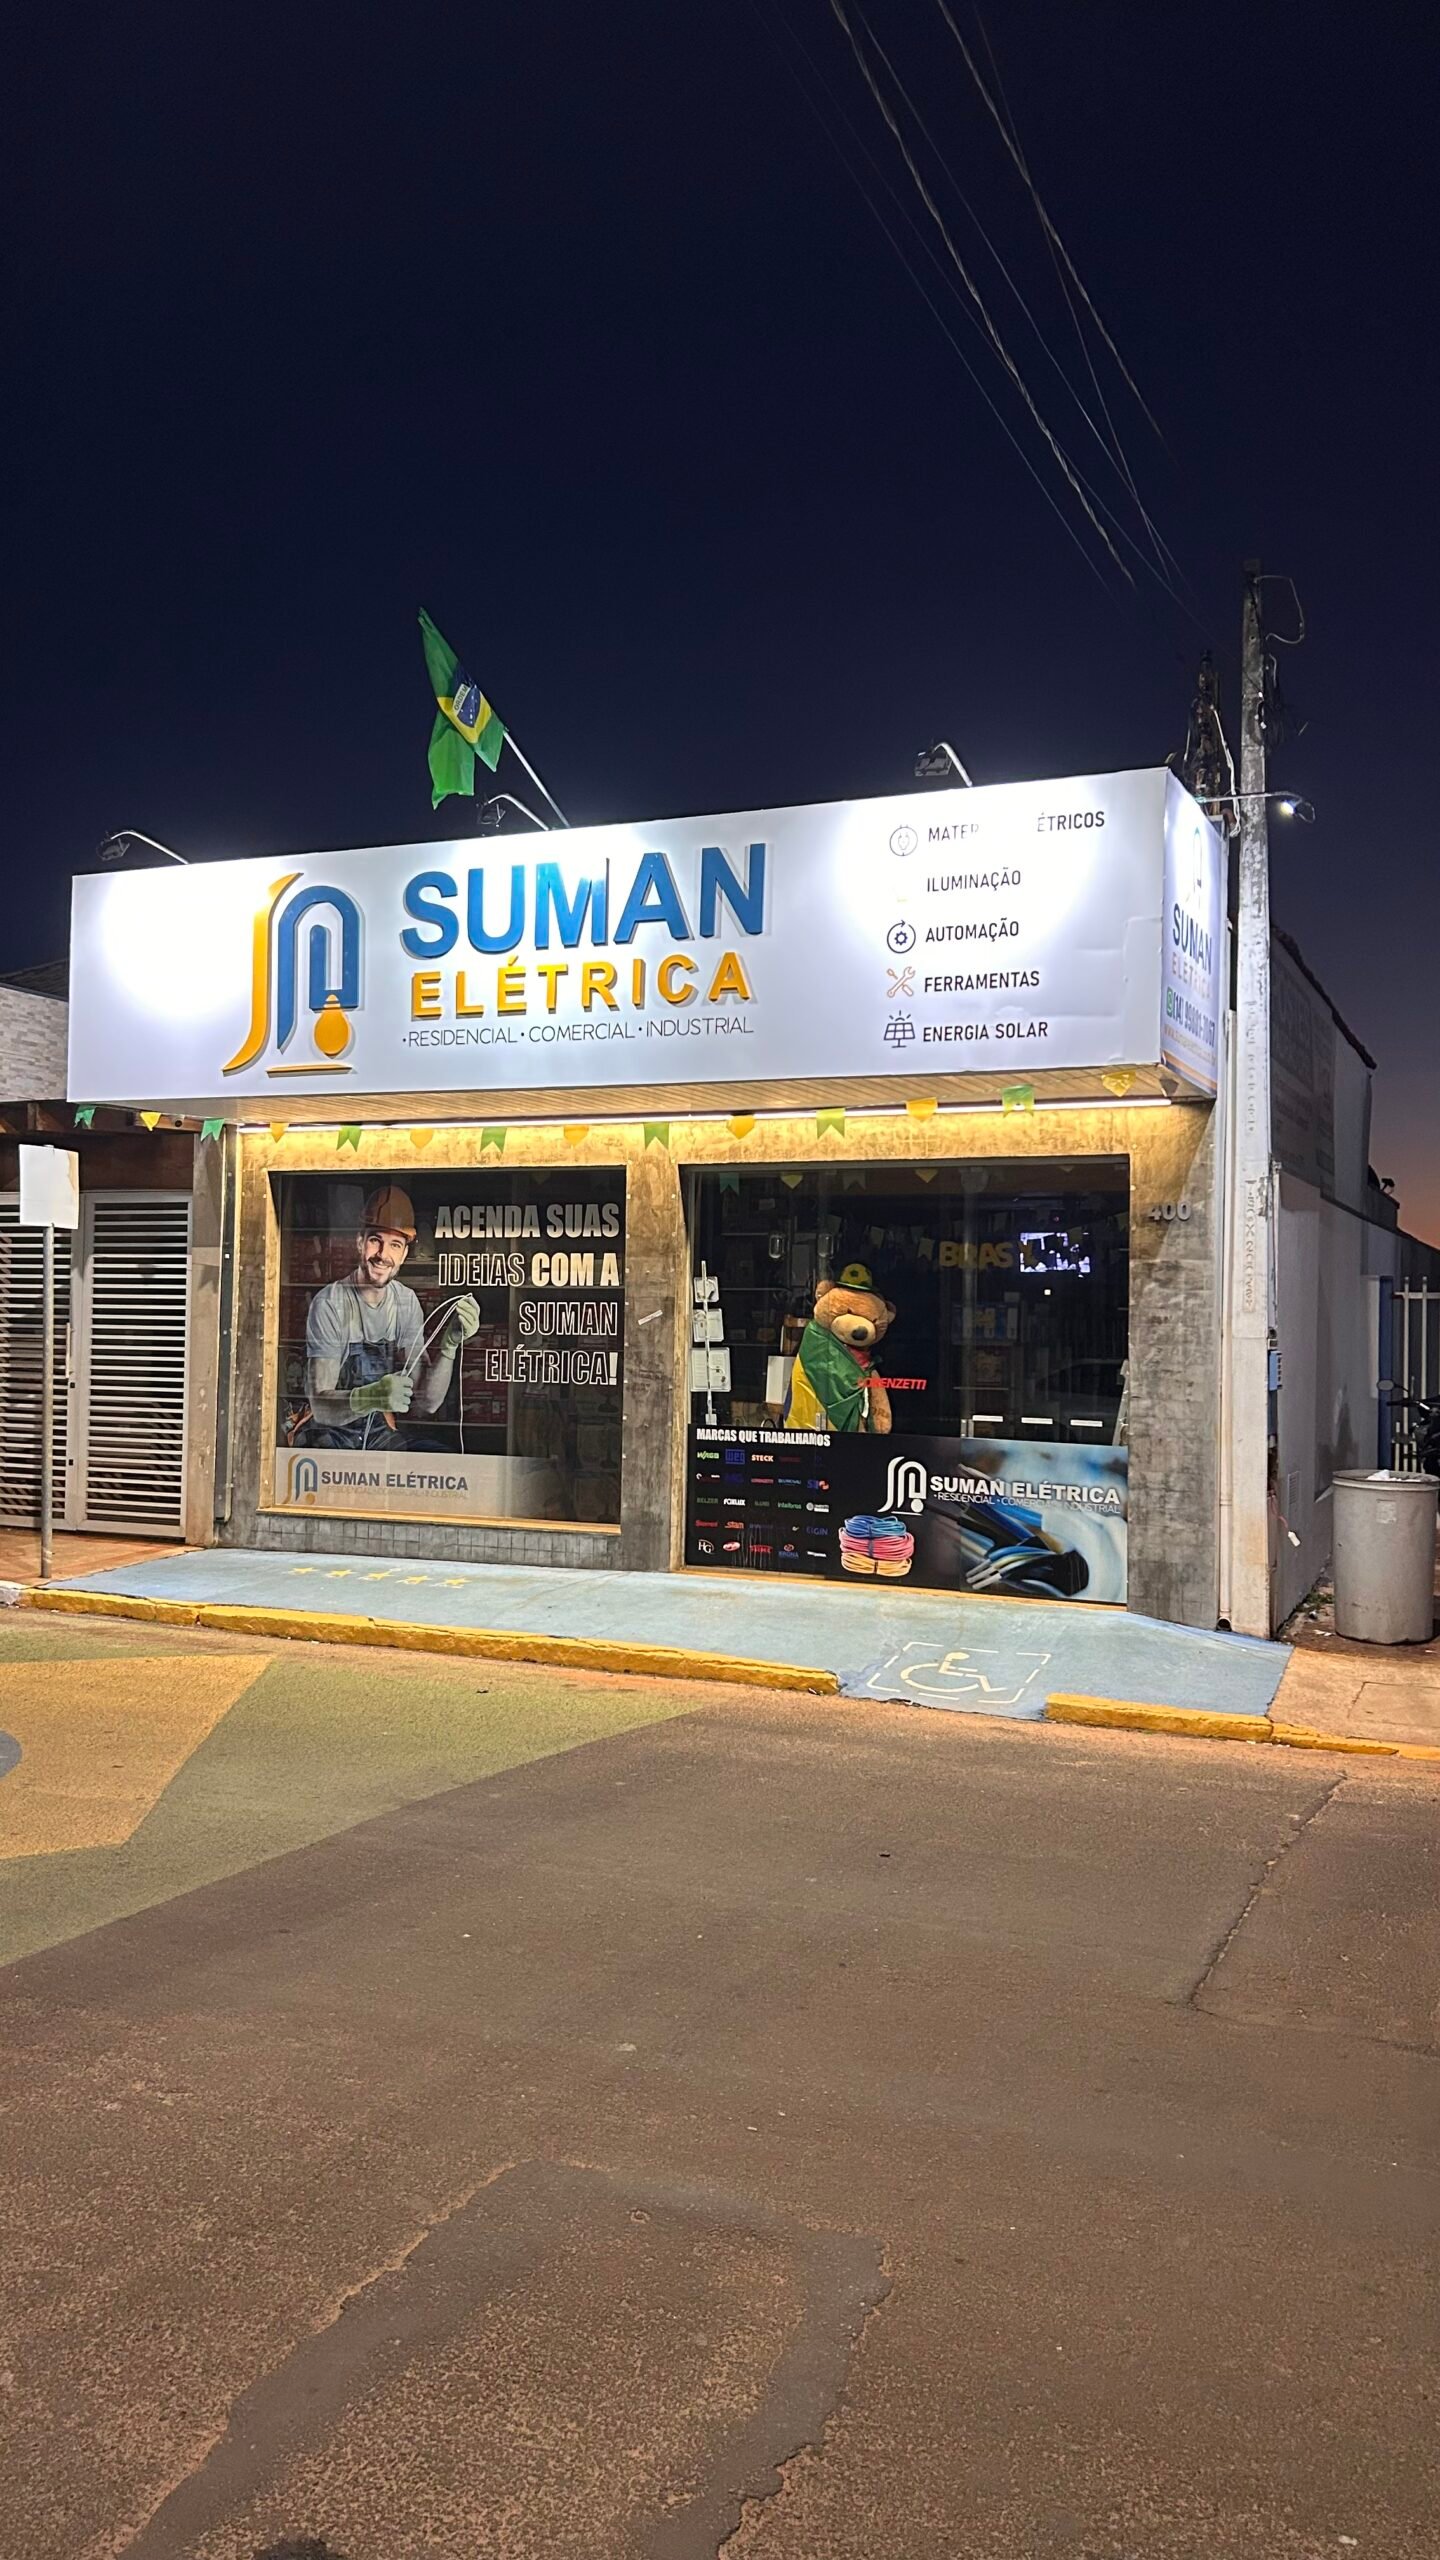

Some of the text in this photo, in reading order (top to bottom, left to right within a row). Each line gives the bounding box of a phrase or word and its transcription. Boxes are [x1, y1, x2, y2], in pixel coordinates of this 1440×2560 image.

[454, 686, 468, 711] ORDEM
[1037, 811, 1105, 832] ÉTRICOS
[927, 867, 1022, 893] ILUMINAÇÃO
[401, 843, 766, 957] SUMAN
[925, 917, 1020, 943] AUTOMAÇÃO
[411, 954, 752, 1018] ELÉTRICA
[924, 971, 1040, 993] FERRAMENTAS
[408, 1017, 755, 1047] RESIDENCIAL COMERCIAL INDUSTRIAL
[923, 1021, 1049, 1042] ENERGIA SOLAR
[434, 1203, 620, 1239] ACENDA SUAS
[1149, 1201, 1191, 1221] 400
[438, 1252, 620, 1287] IDEIAS COM A
[519, 1301, 617, 1336] SUMAN
[485, 1344, 618, 1386] ELÉTRICA!
[696, 1428, 831, 1447] MARCAS QUE TRABALHAMOS
[752, 1454, 774, 1462] STECK
[321, 1471, 468, 1490] SUMAN ELÉTRICA
[930, 1476, 1120, 1504] SUMAN ELÉTRICA
